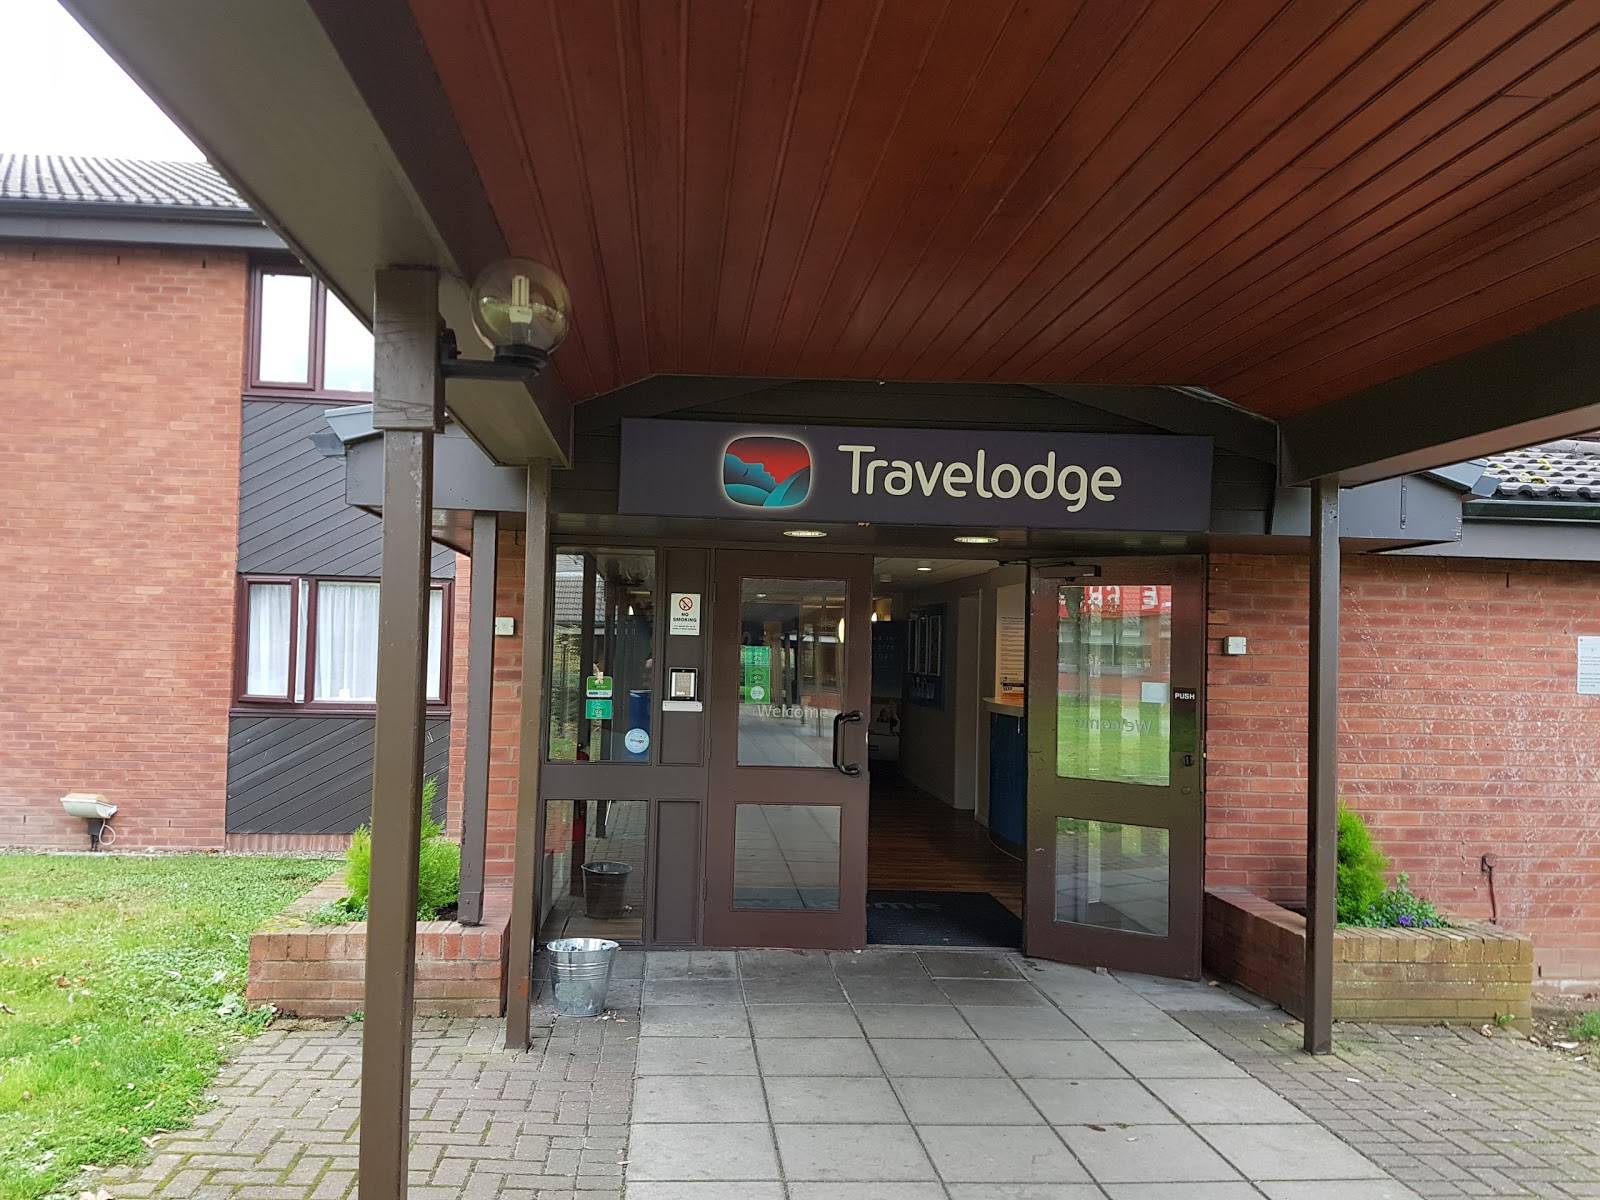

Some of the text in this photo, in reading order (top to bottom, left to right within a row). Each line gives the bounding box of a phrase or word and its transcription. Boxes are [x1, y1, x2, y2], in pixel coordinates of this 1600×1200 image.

[837, 443, 1122, 512] Travelodge
[1174, 692, 1195, 700] PUSH
[757, 704, 828, 718] Welcome
